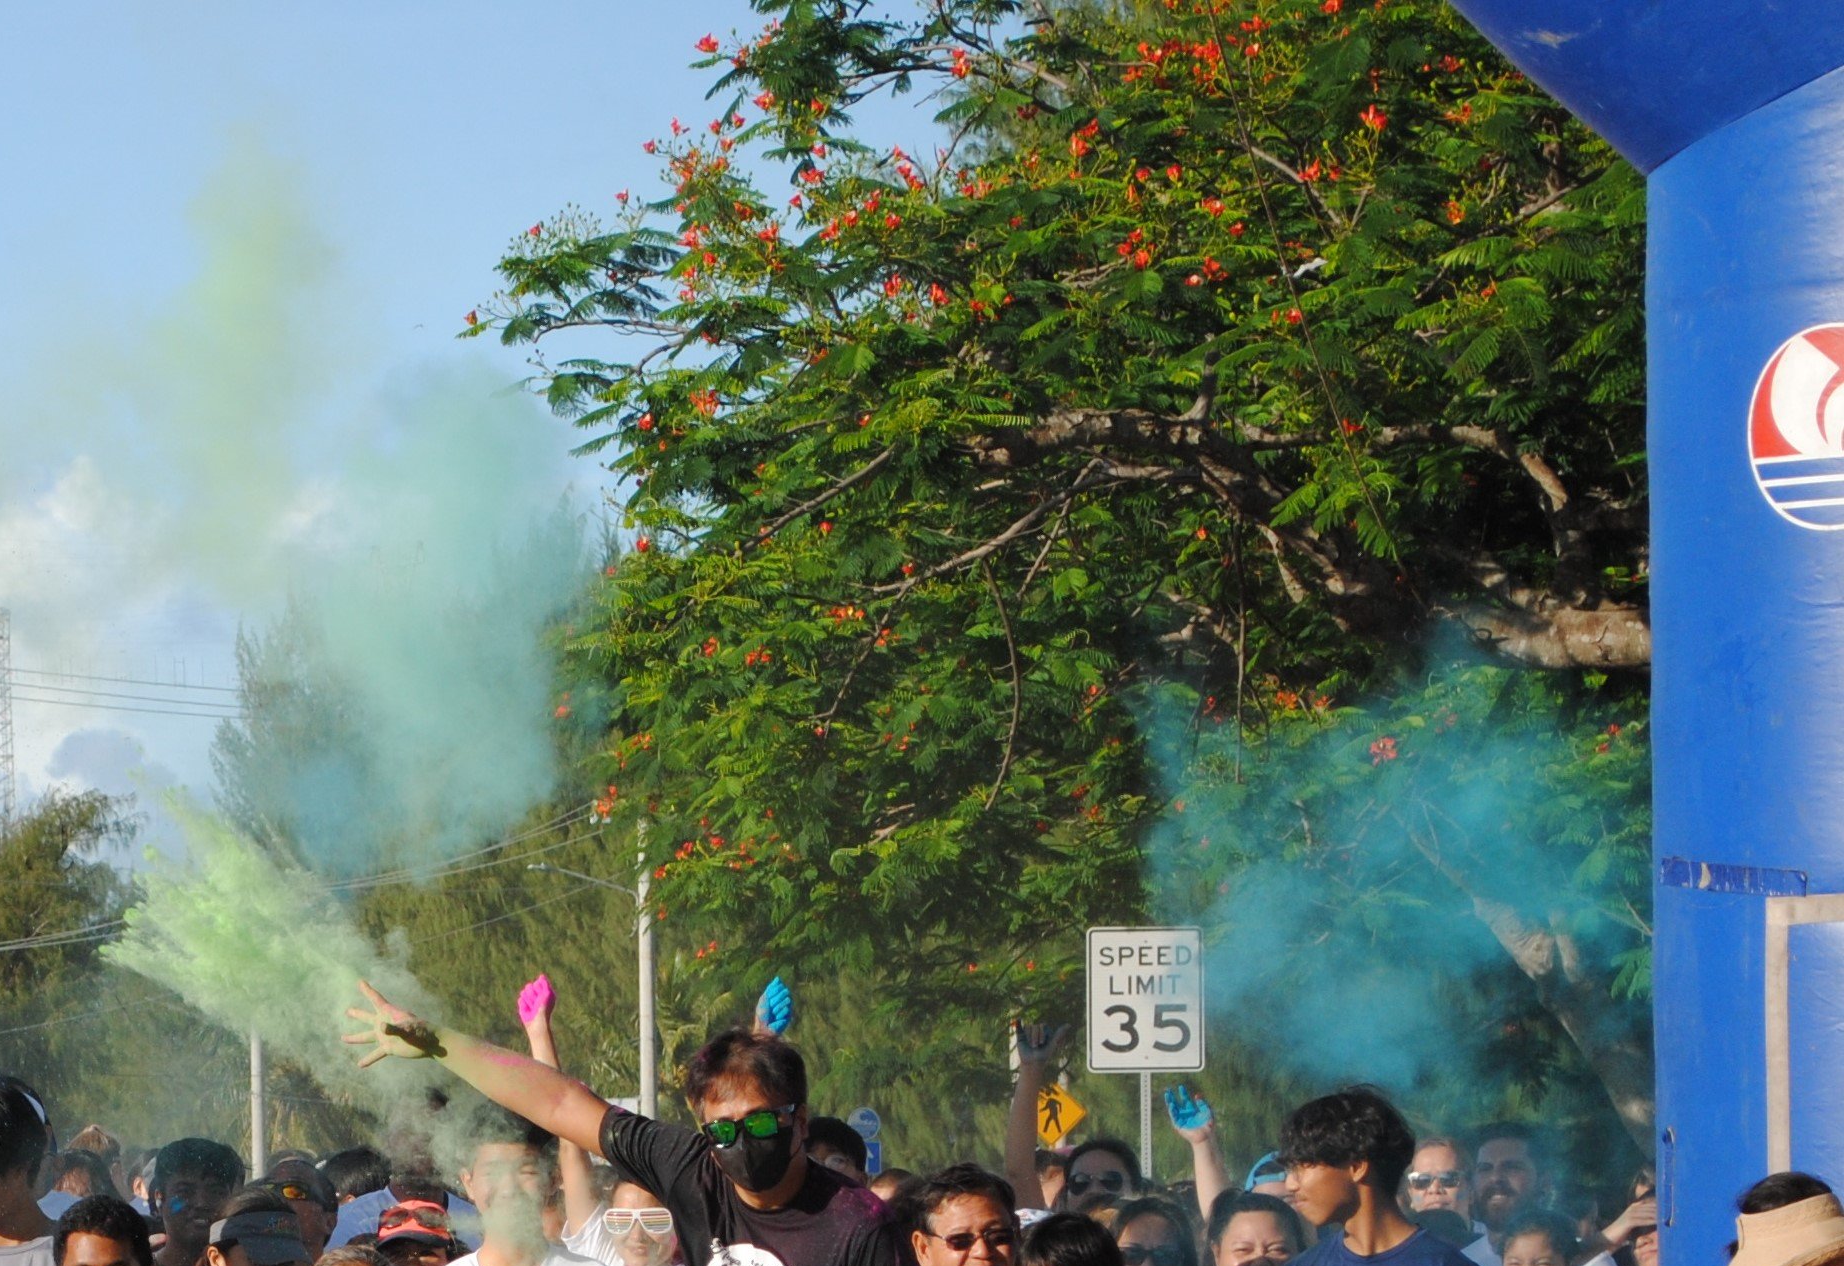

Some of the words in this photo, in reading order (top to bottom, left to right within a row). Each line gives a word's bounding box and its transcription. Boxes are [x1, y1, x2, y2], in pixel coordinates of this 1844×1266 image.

[1099, 945, 1192, 966] SPEED
[1109, 975, 1181, 995] LIMIT
[1101, 1003, 1191, 1053] 35
